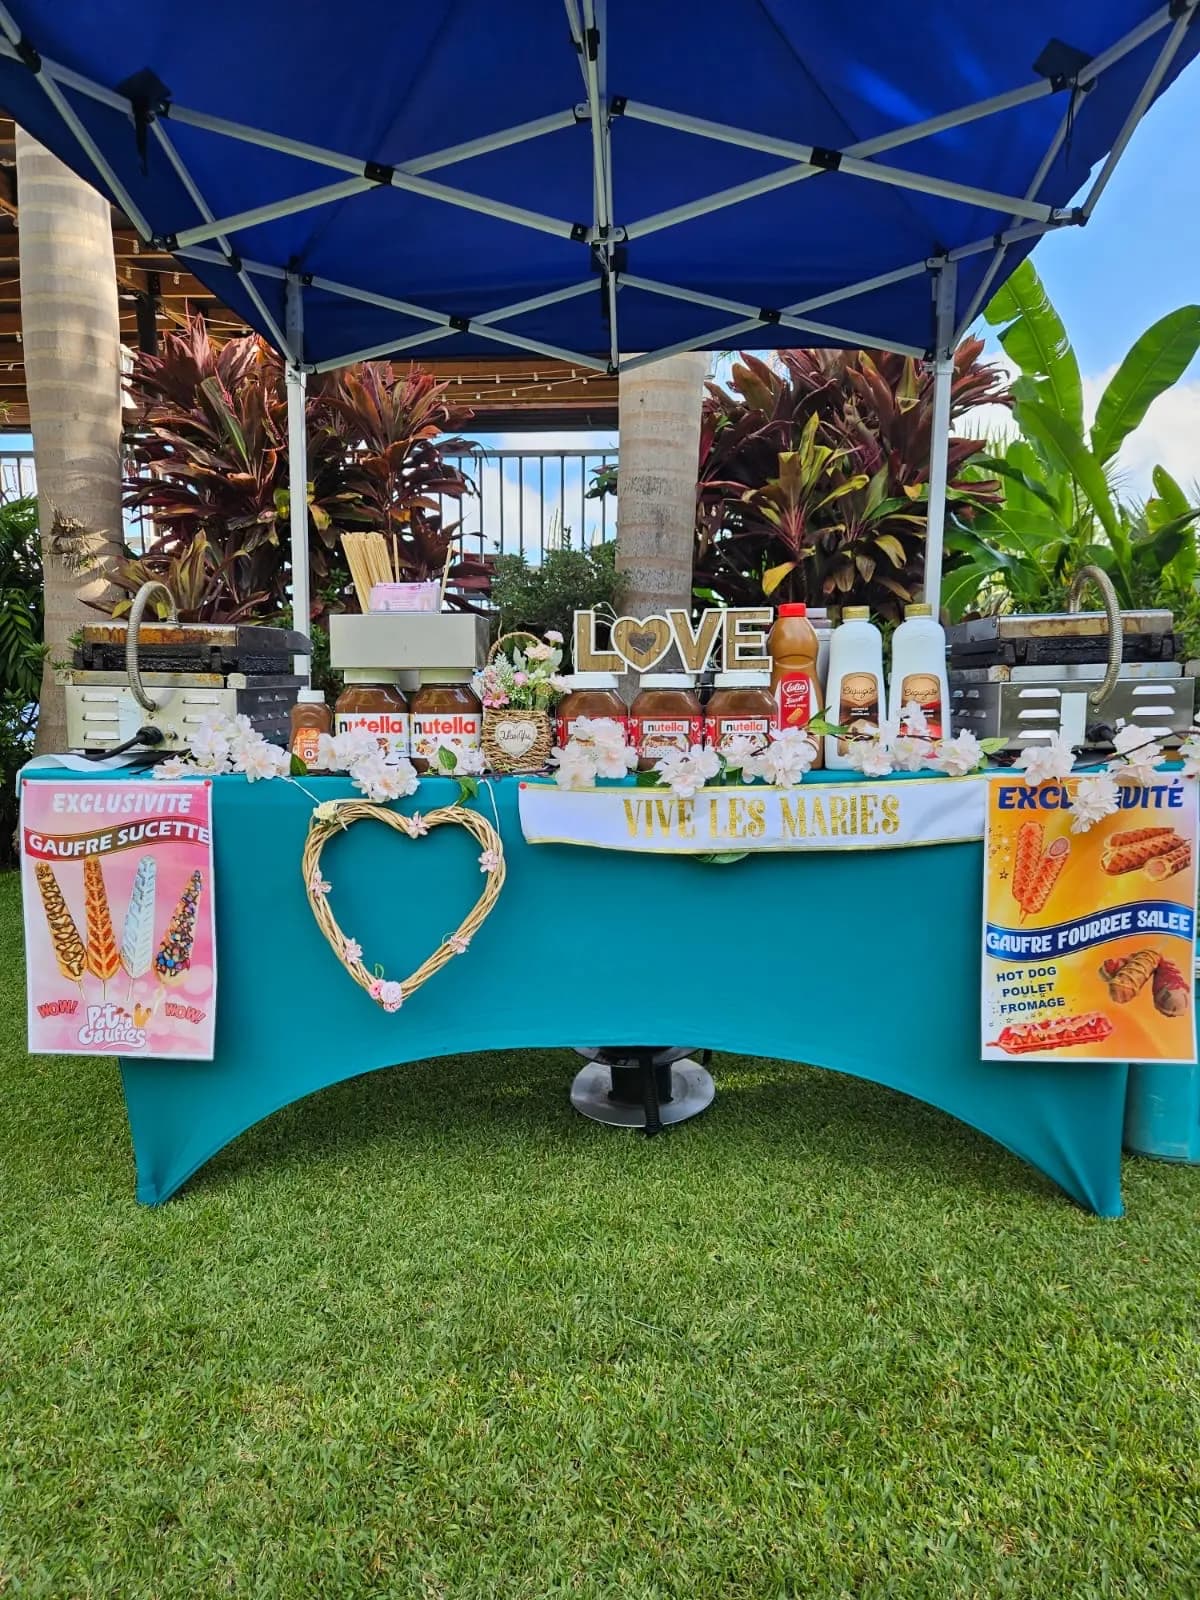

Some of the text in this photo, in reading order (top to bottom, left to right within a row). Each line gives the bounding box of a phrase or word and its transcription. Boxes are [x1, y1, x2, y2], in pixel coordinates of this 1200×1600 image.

[414, 716, 476, 735] nutella
[647, 724, 684, 732] nutella
[726, 724, 763, 732] nutella
[53, 793, 193, 814] EXCLUSIVITE
[623, 798, 696, 839] VIVE
[709, 797, 766, 838] LES
[28, 820, 211, 857] GAUFRE SUCETTE
[987, 910, 1191, 954] GAUFRE FOURREE SALEE
[996, 966, 1057, 982] HOT DOG
[1002, 982, 1055, 998] POULET
[36, 999, 79, 1018] WOW!
[165, 1002, 206, 1024] WOW!
[1000, 997, 1066, 1014] FROMAGE
